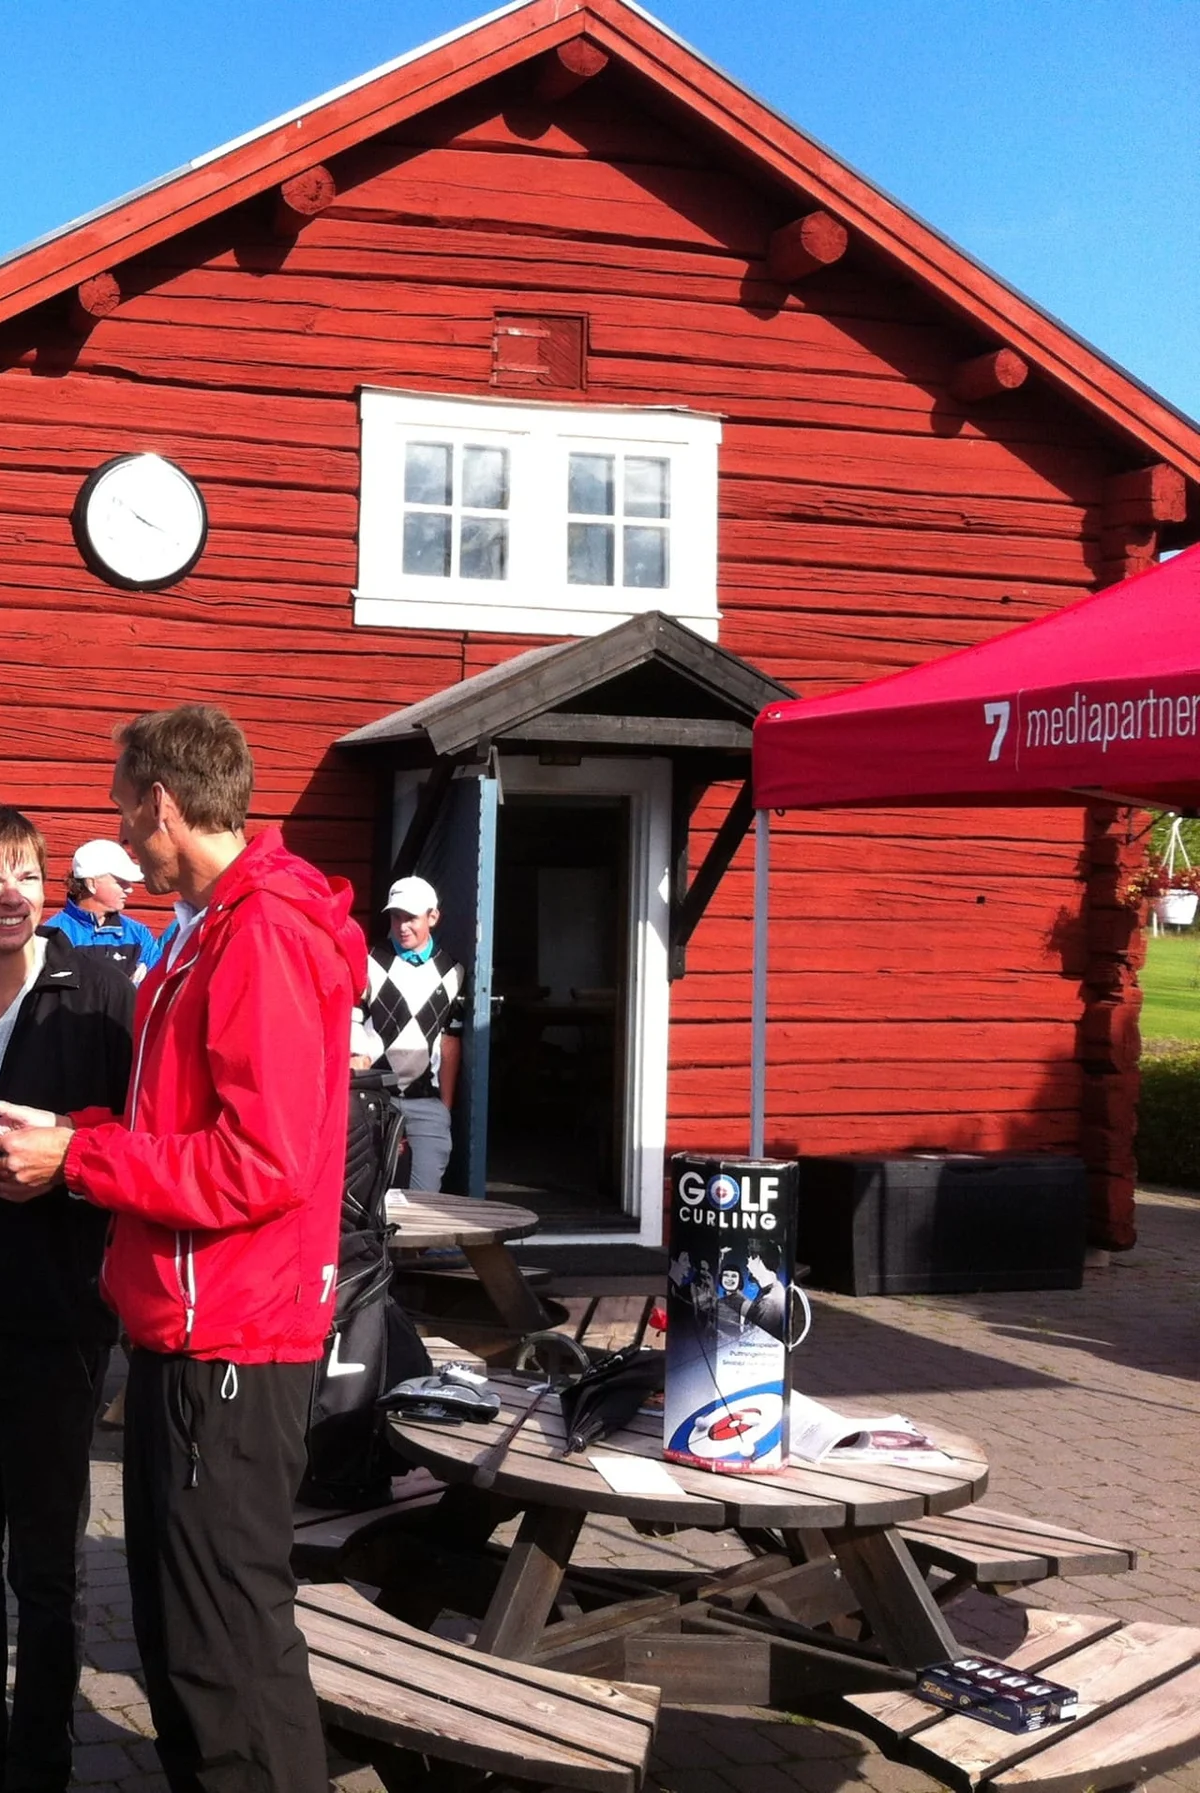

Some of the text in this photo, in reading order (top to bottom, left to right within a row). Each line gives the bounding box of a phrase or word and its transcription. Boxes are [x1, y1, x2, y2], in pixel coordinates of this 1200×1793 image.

[984, 700, 1011, 762] 7
[678, 1171, 780, 1212] GOLF
[679, 1206, 777, 1231] CURLING
[320, 1263, 335, 1303] 7
